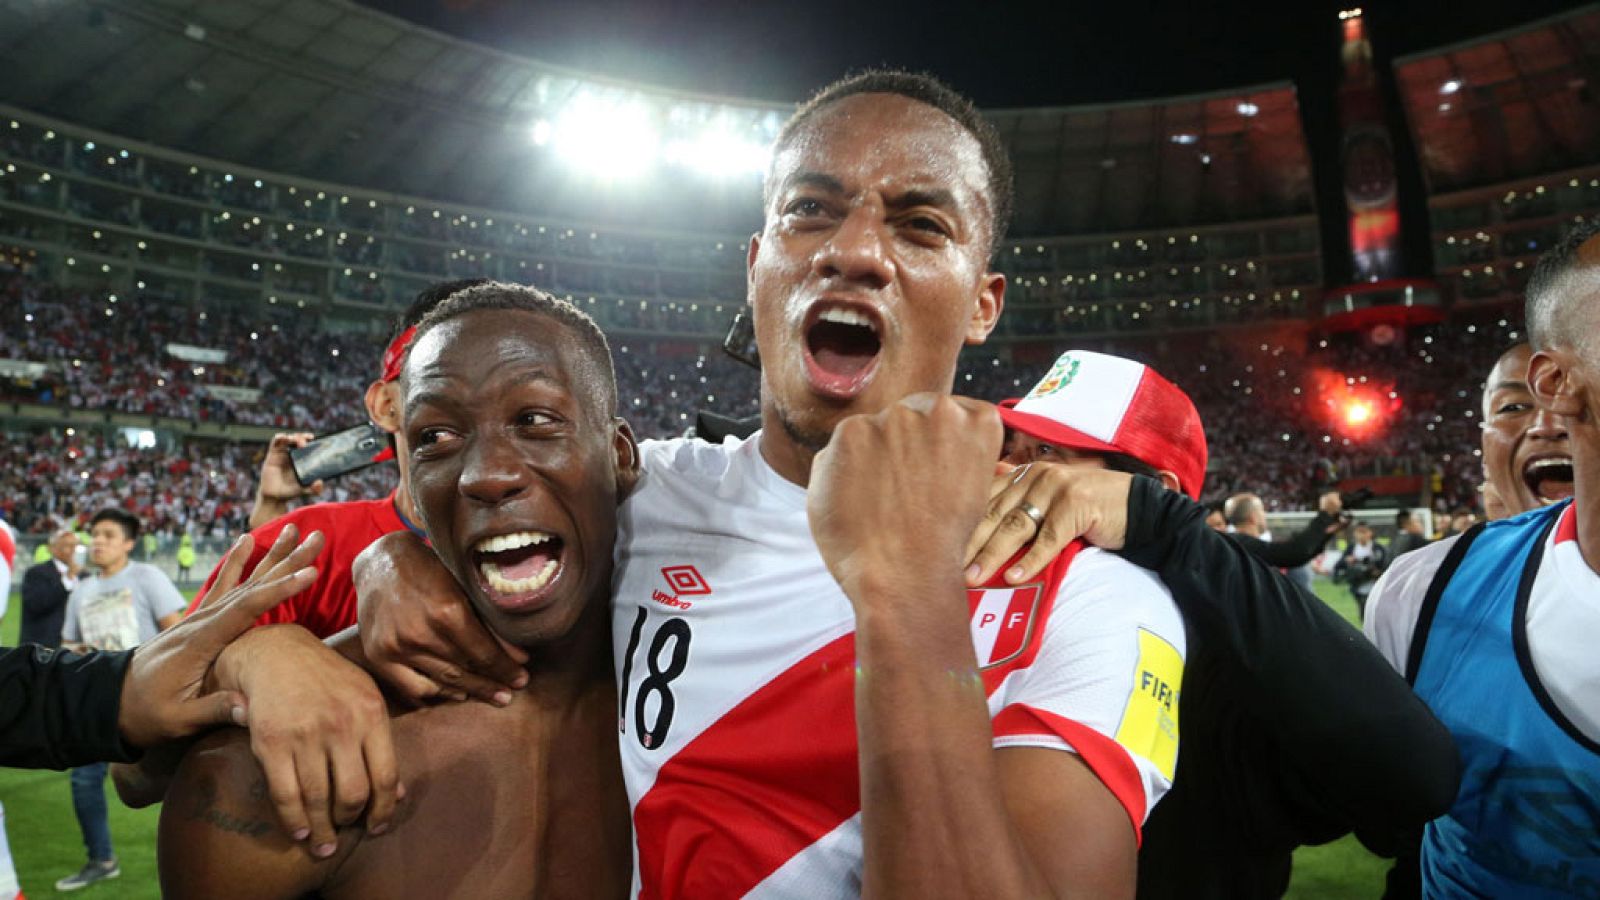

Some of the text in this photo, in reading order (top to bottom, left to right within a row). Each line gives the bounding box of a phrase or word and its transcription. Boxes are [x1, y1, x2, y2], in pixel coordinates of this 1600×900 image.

[652, 588, 692, 610] umbro
[620, 605, 692, 750] 18
[1141, 670, 1173, 712] FIFA
